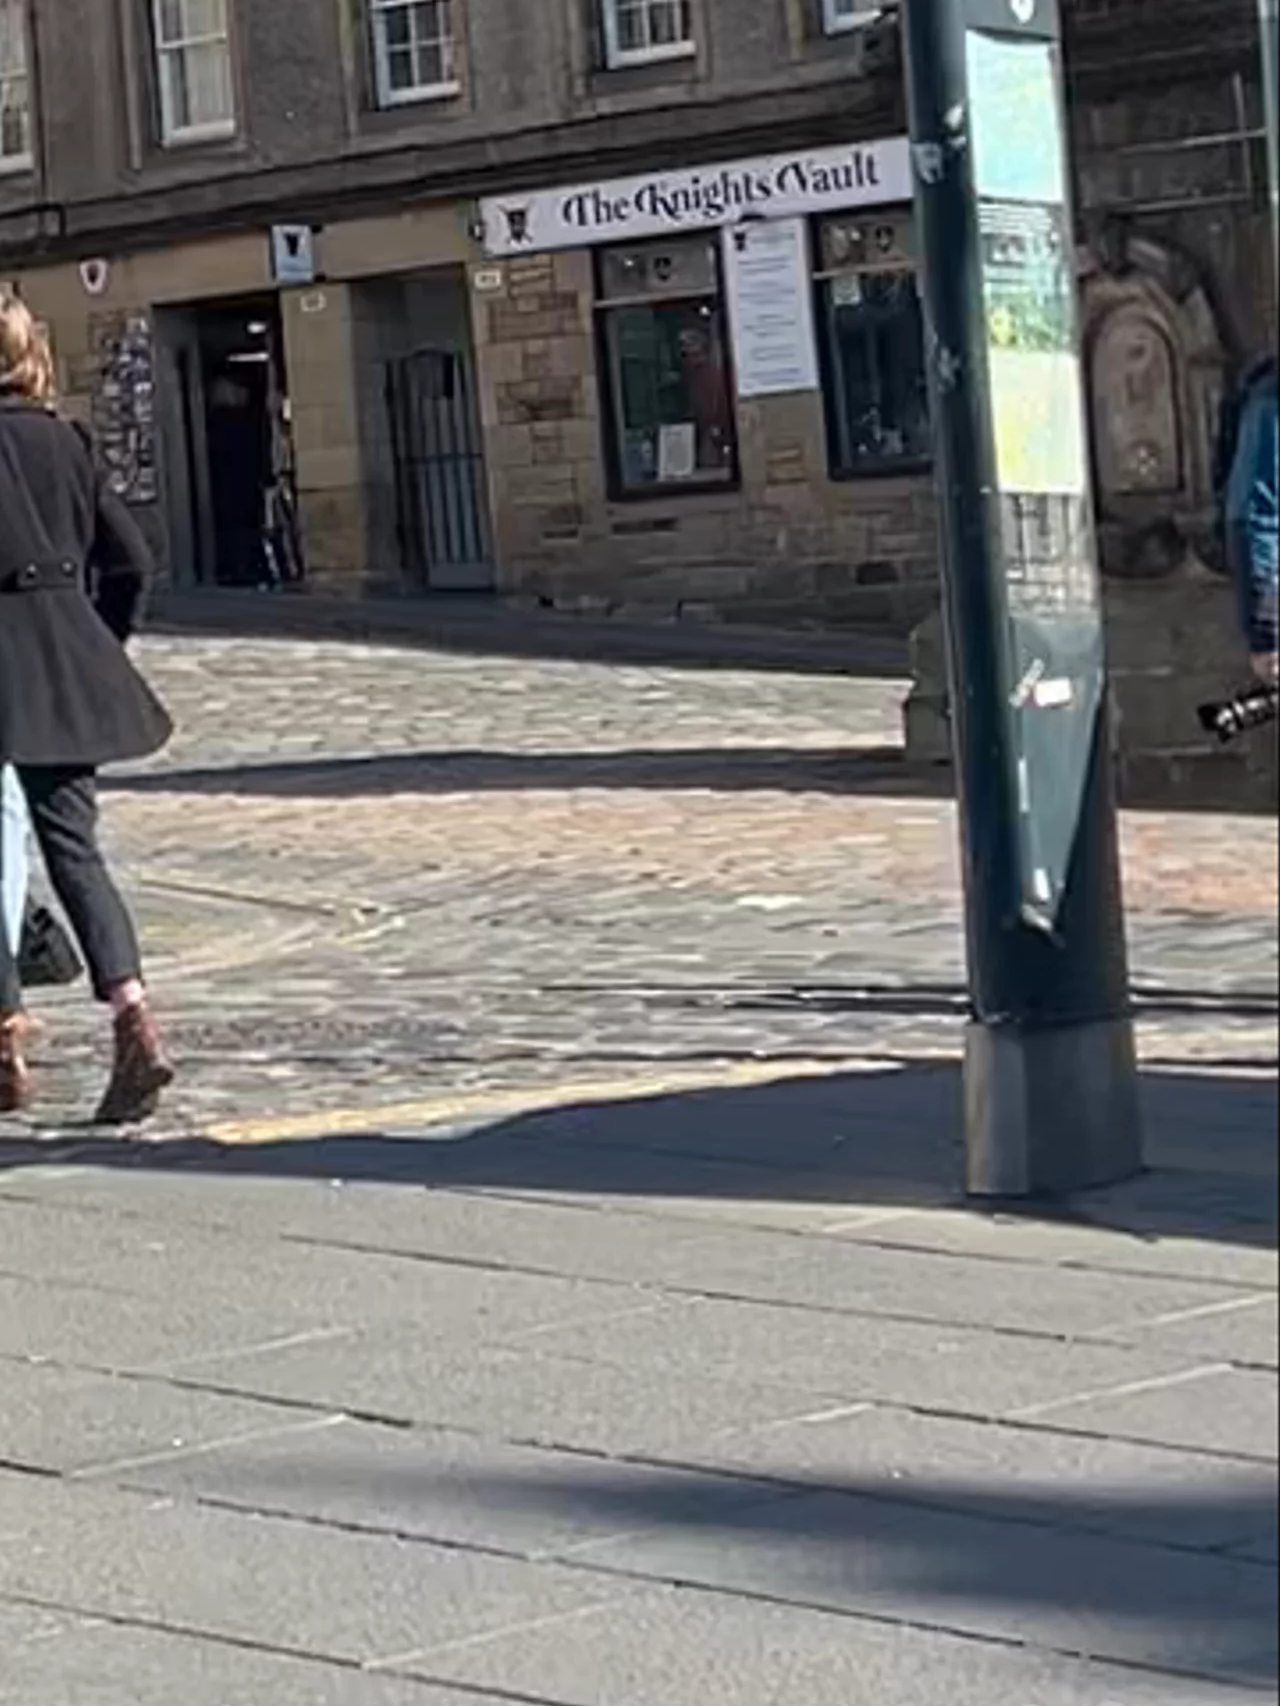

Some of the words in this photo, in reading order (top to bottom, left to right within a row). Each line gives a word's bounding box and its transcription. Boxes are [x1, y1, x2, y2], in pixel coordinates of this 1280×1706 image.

[562, 190, 631, 227] The
[634, 170, 773, 219] Knights
[776, 151, 880, 196] Vault
